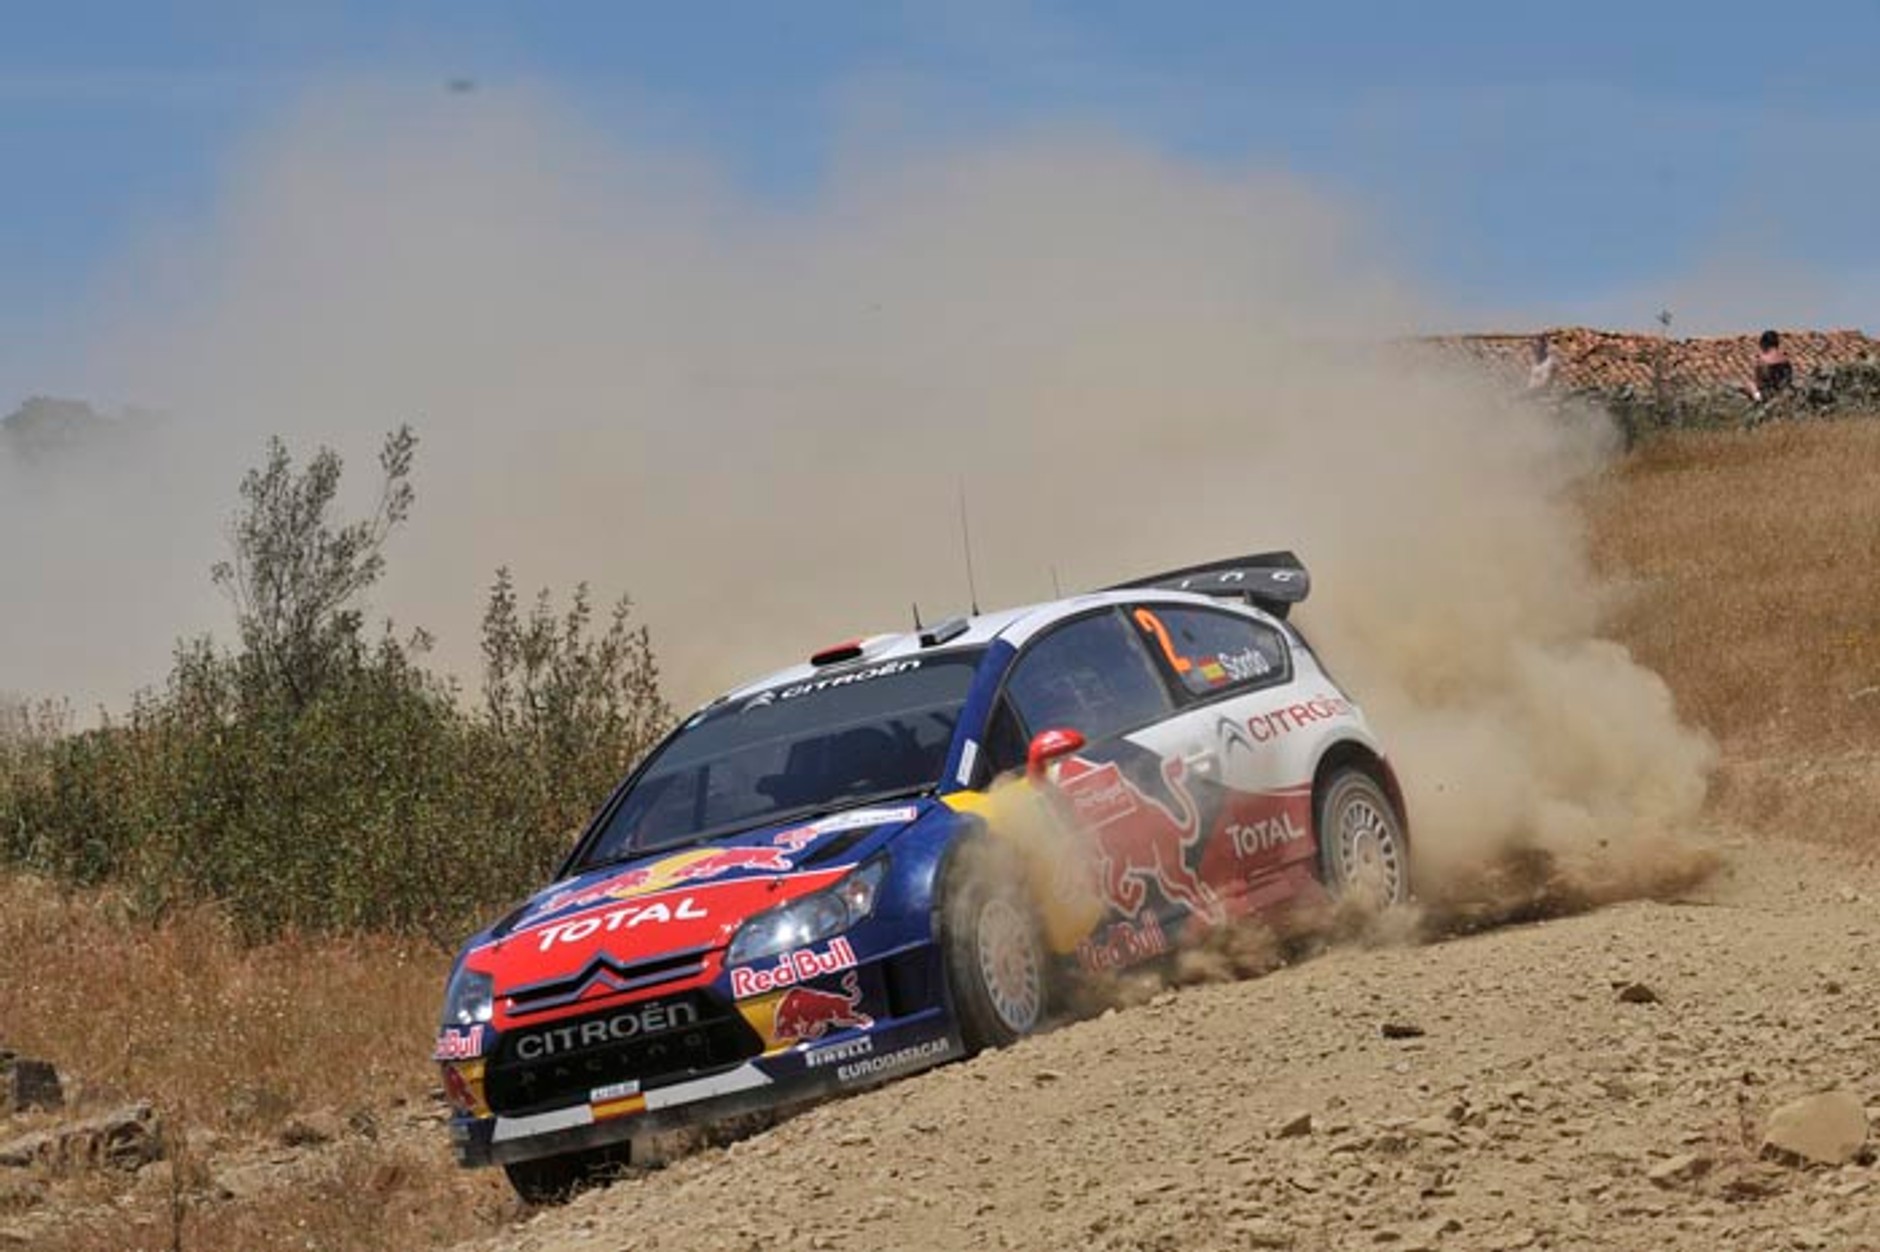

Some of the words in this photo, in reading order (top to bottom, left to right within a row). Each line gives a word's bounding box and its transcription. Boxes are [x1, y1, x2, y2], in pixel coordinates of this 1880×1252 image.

[1133, 608, 1191, 673] 2
[1224, 809, 1307, 859] TOTAL
[537, 898, 708, 952] TOTAL
[731, 952, 796, 998] Red
[793, 935, 859, 983] Bull
